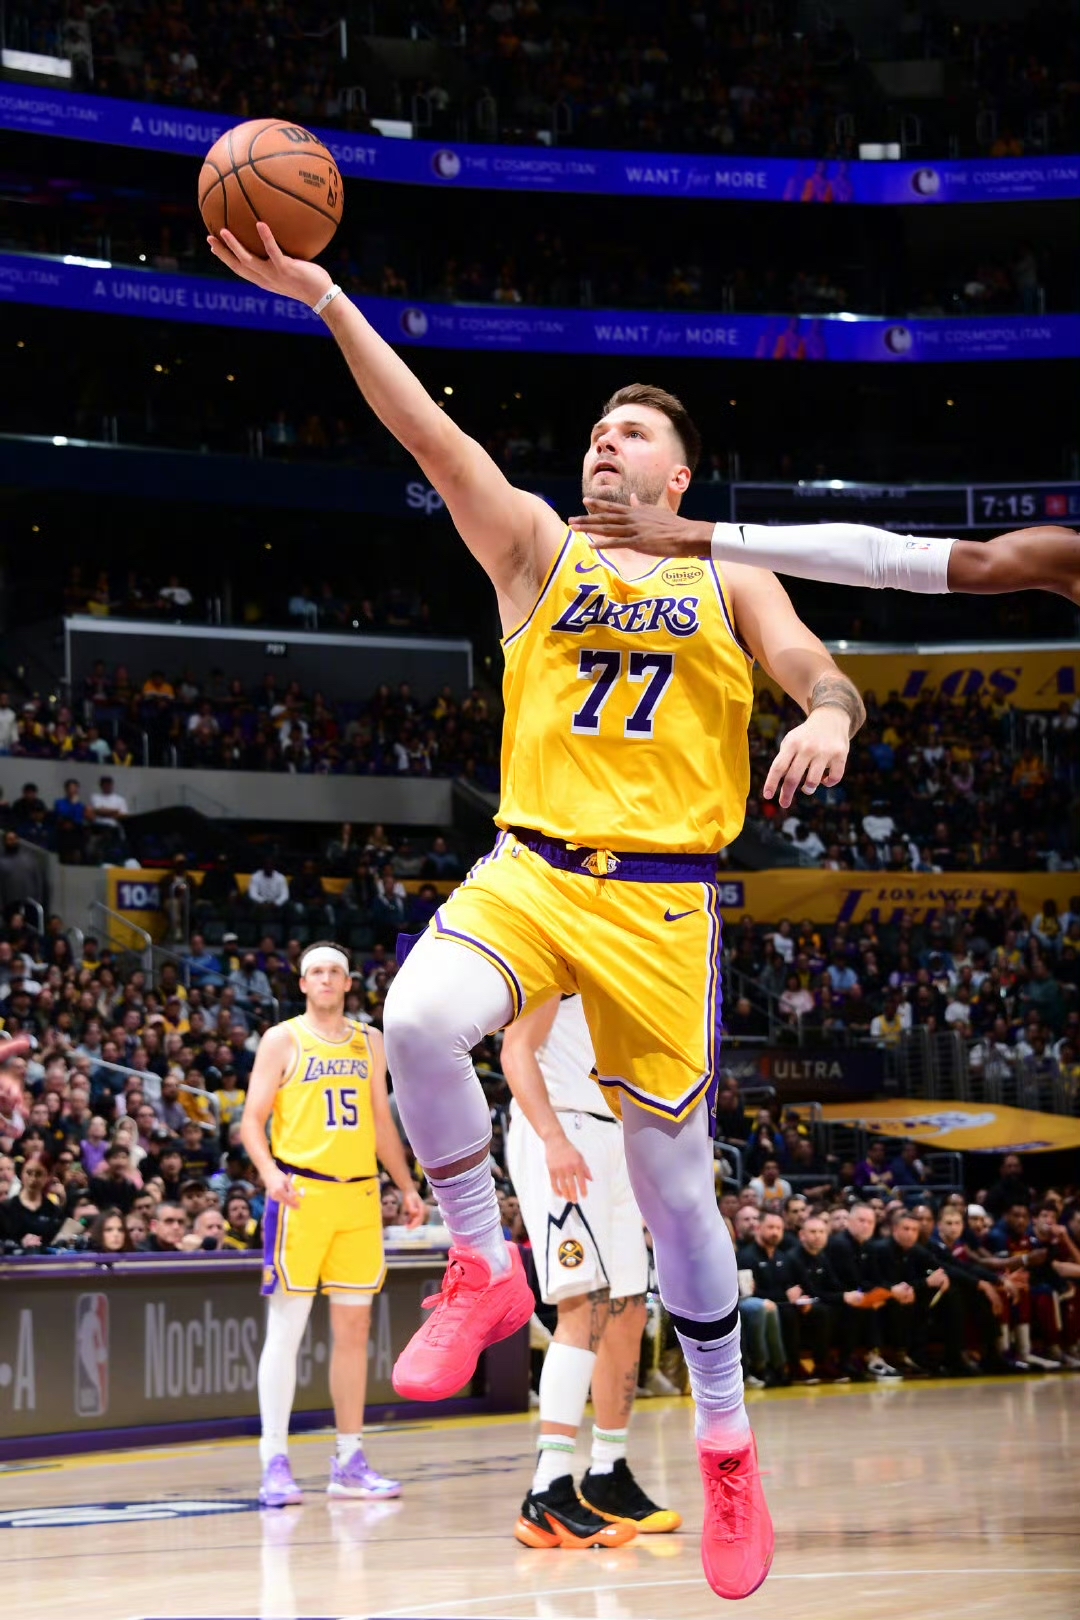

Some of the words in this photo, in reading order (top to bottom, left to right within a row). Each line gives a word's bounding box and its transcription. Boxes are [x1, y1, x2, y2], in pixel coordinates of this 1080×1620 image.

[130, 117, 144, 133] A
[150, 119, 221, 144] UNIQUE
[331, 145, 377, 166] SORT
[465, 156, 488, 171] THE
[494, 158, 596, 176] COSMOPOLITAN
[944, 172, 967, 185] THE
[973, 167, 1079, 184] COSMOPOLITAN
[626, 167, 680, 185] WANT
[684, 168, 711, 190] for
[715, 171, 767, 188] MORE
[94, 280, 107, 296] A
[113, 282, 186, 307] UNIQUE
[193, 292, 268, 316] LUXURY
[432, 315, 455, 330] THE
[460, 317, 564, 334] COSMOPOLITAN
[916, 330, 939, 344] THE
[946, 327, 1051, 343] COSMOPOLITAN
[594, 325, 650, 342] WANT
[655, 326, 681, 348] for
[686, 328, 738, 345] MORE
[981, 495, 1035, 517] 7:15
[665, 571, 701, 580] bibigo
[551, 584, 700, 638] LAKERS
[901, 666, 1022, 698] LOS
[571, 648, 676, 740] 77
[302, 1056, 369, 1083] LAKERS
[773, 1061, 842, 1080] ULTRA
[324, 1089, 359, 1130] 15
[145, 1300, 257, 1398] Noches
